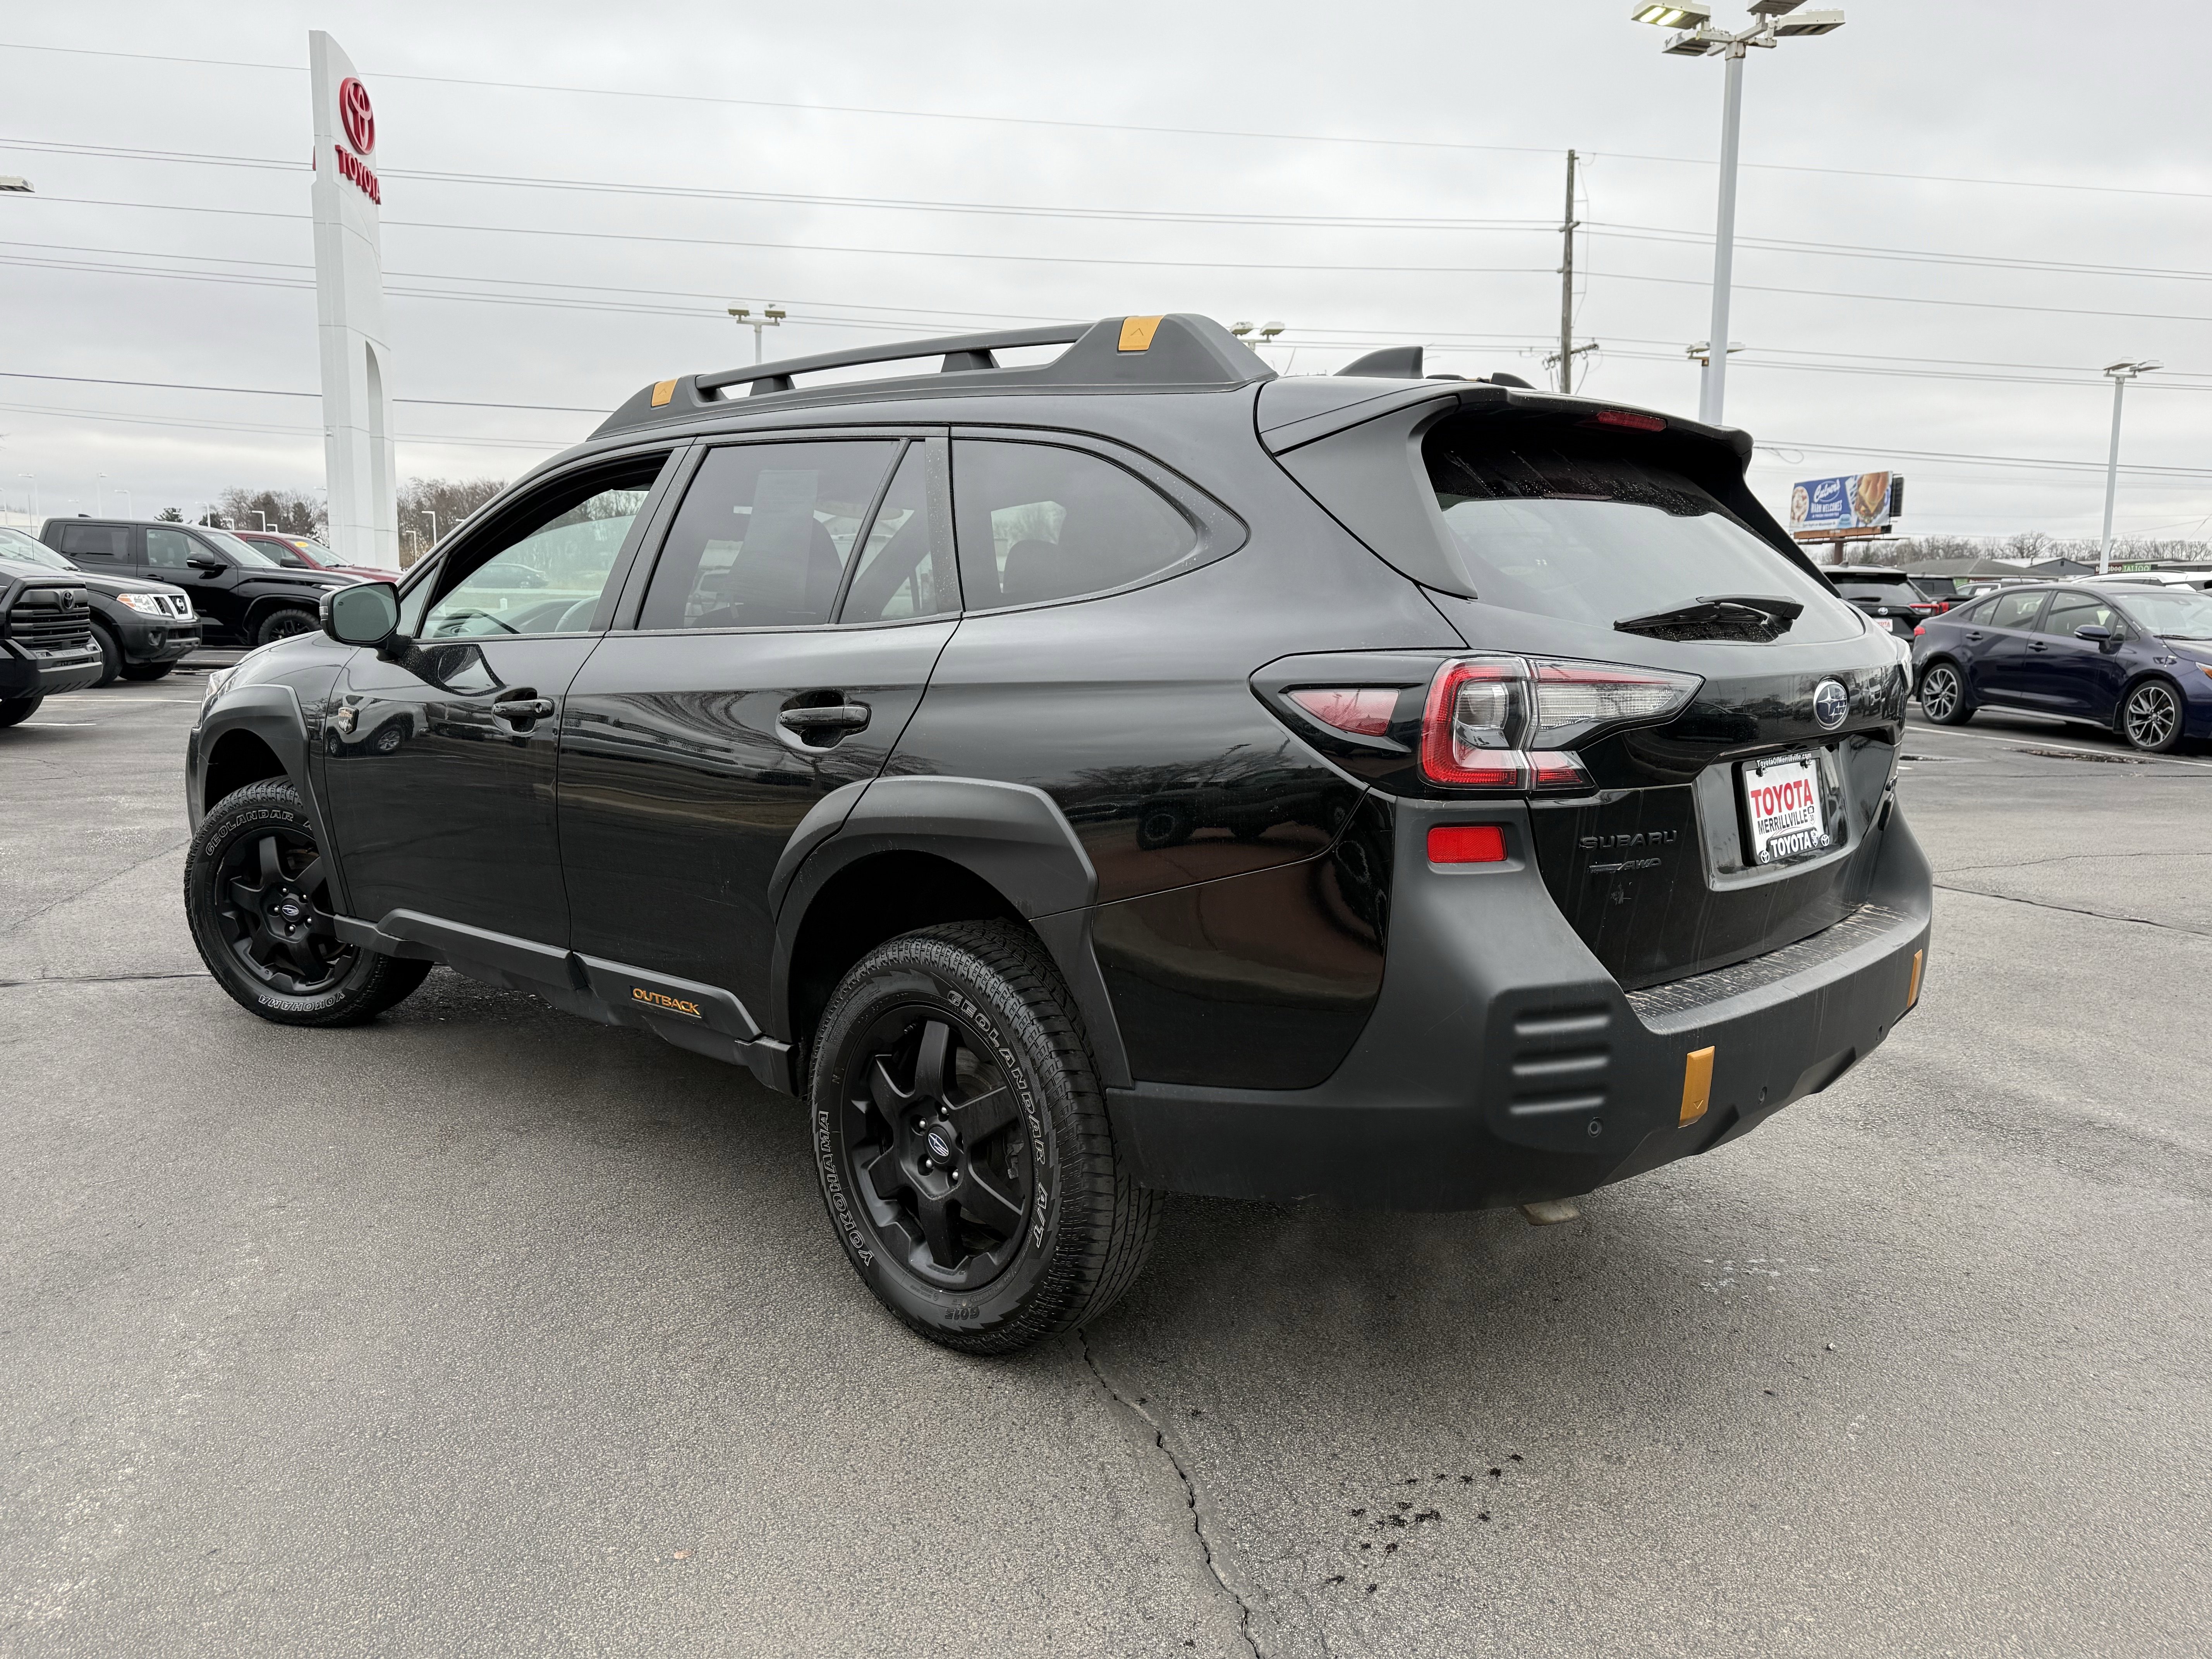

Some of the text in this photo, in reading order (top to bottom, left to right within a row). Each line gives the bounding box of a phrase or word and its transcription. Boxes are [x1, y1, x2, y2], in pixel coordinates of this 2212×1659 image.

[335, 145, 381, 205] TOYOTA
[1822, 500, 1843, 513] WELCOMES
[1751, 779, 1814, 818] TOYOTA
[206, 809, 294, 855] GEOLANDAR
[1757, 809, 1808, 835] MERRILLVILLE
[1579, 830, 1677, 849] SUBARU
[1770, 832, 1812, 858] TOYOTA
[1618, 858, 1662, 870] AWD
[258, 991, 346, 1012] YOKOHAMA
[632, 988, 700, 1015] OUTBACK
[947, 990, 1048, 1249] GEOLANDAR A/T
[816, 1110, 874, 1266] YOKOHAMA
